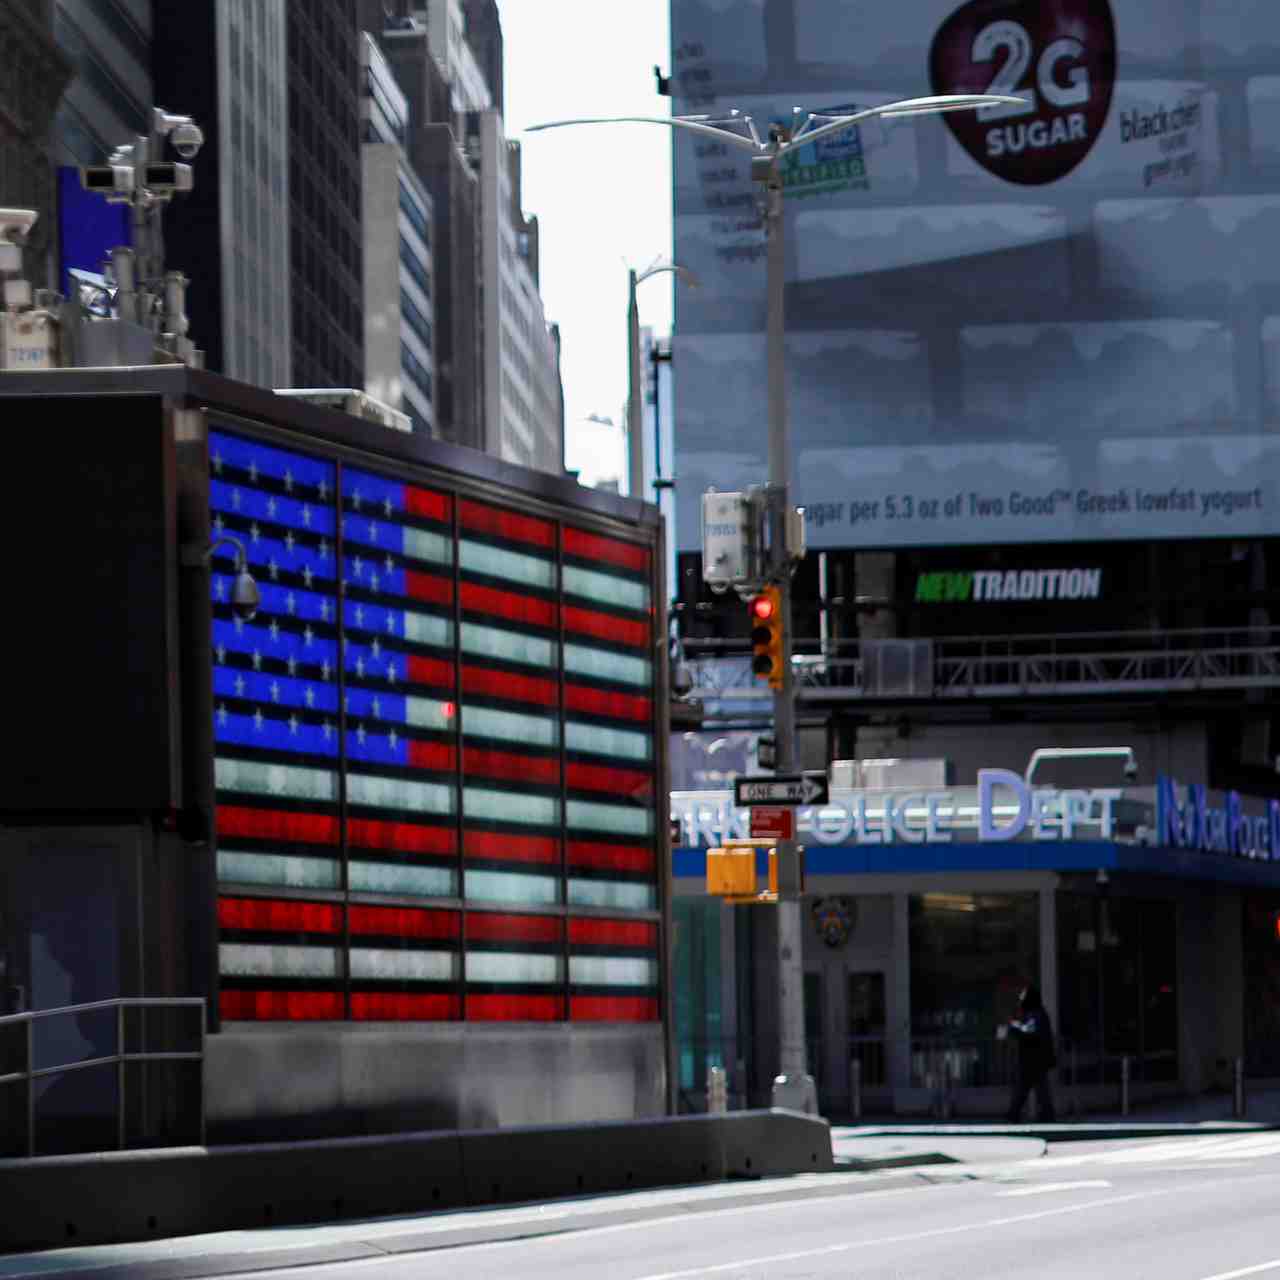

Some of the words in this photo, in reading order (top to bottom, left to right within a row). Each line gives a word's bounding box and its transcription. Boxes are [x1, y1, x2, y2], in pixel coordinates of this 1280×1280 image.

[972, 19, 1089, 122] 2G
[986, 113, 1088, 156] SUGAR
[805, 500, 842, 524] ugar
[852, 500, 877, 524] per
[885, 495, 911, 518] 5.3
[918, 498, 938, 518] oz
[944, 493, 959, 517] of
[968, 492, 1003, 516] Two
[1076, 488, 1130, 513] Greek
[1136, 487, 1195, 511] lowfat
[1202, 487, 1264, 515] yogurt
[748, 784, 773, 799] ONE
[787, 783, 814, 799] WAY
[798, 790, 953, 844] OLICE
